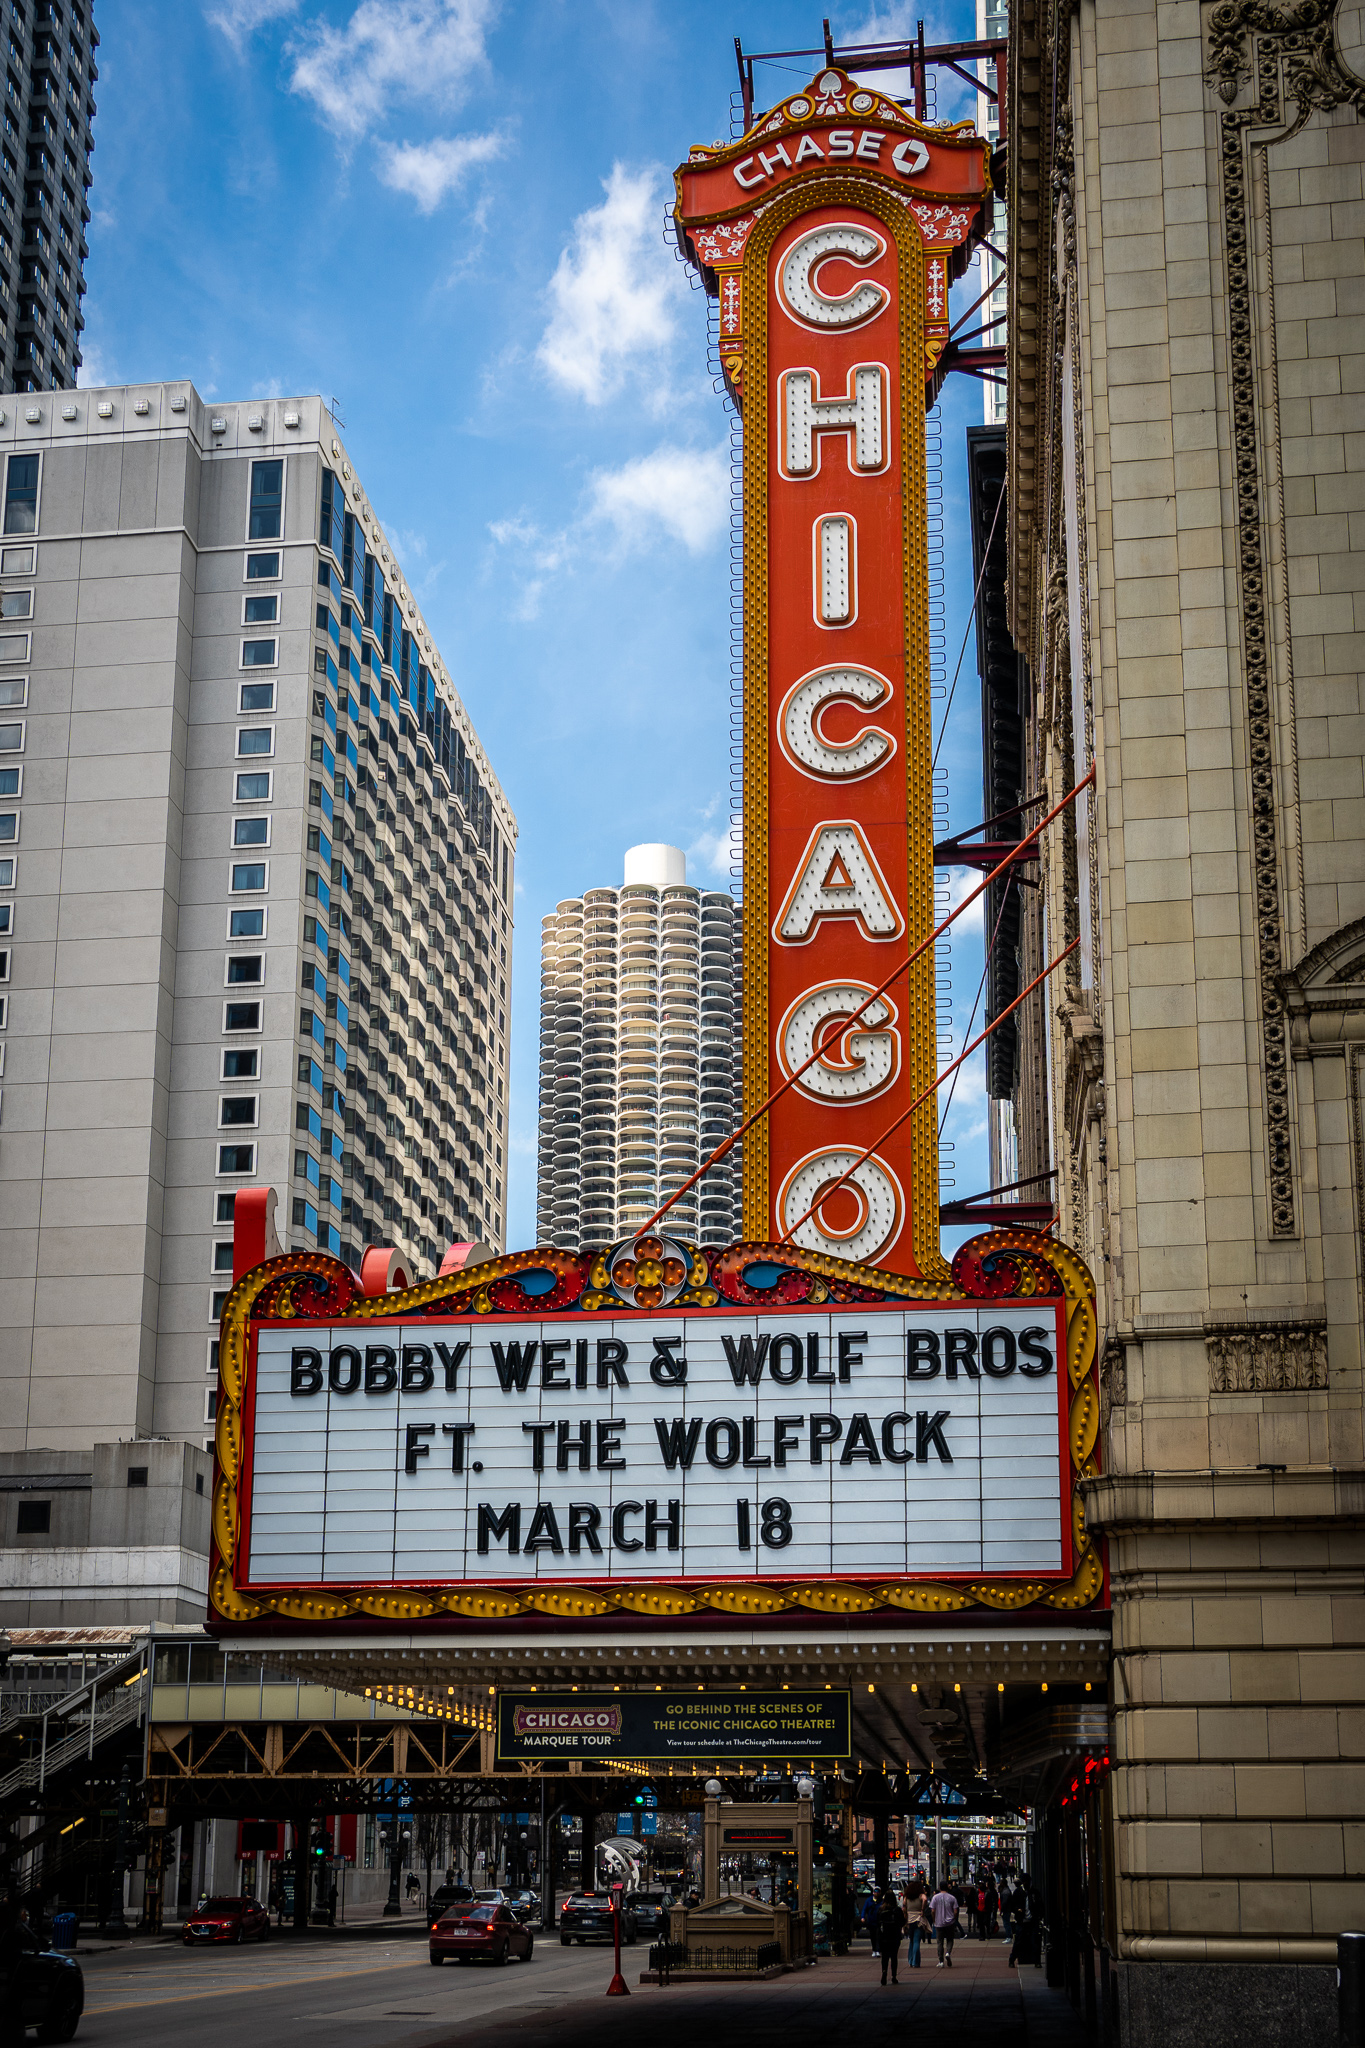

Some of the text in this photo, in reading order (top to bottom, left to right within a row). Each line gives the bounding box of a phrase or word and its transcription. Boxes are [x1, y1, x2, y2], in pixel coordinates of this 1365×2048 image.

[733, 130, 887, 190] CHASE
[772, 222, 907, 1267] CHICAGO
[290, 1325, 1055, 1397] BOBBY WEIR & WOLF BROS
[404, 1409, 954, 1475] FT. THE WOLFPACK
[476, 1495, 794, 1556] MARCH 18
[666, 1703, 823, 1715] GO BEHIND THE SCENES OF
[525, 1713, 610, 1727] CHICAGO
[653, 1719, 836, 1730] THE ICONIC CHICAGO THEATRE!
[523, 1735, 612, 1748] MARQUEE TOUR
[733, 1738, 822, 1748] TheChicagoTheatre.com/tour
[744, 1829, 773, 1837] SUBWAY
